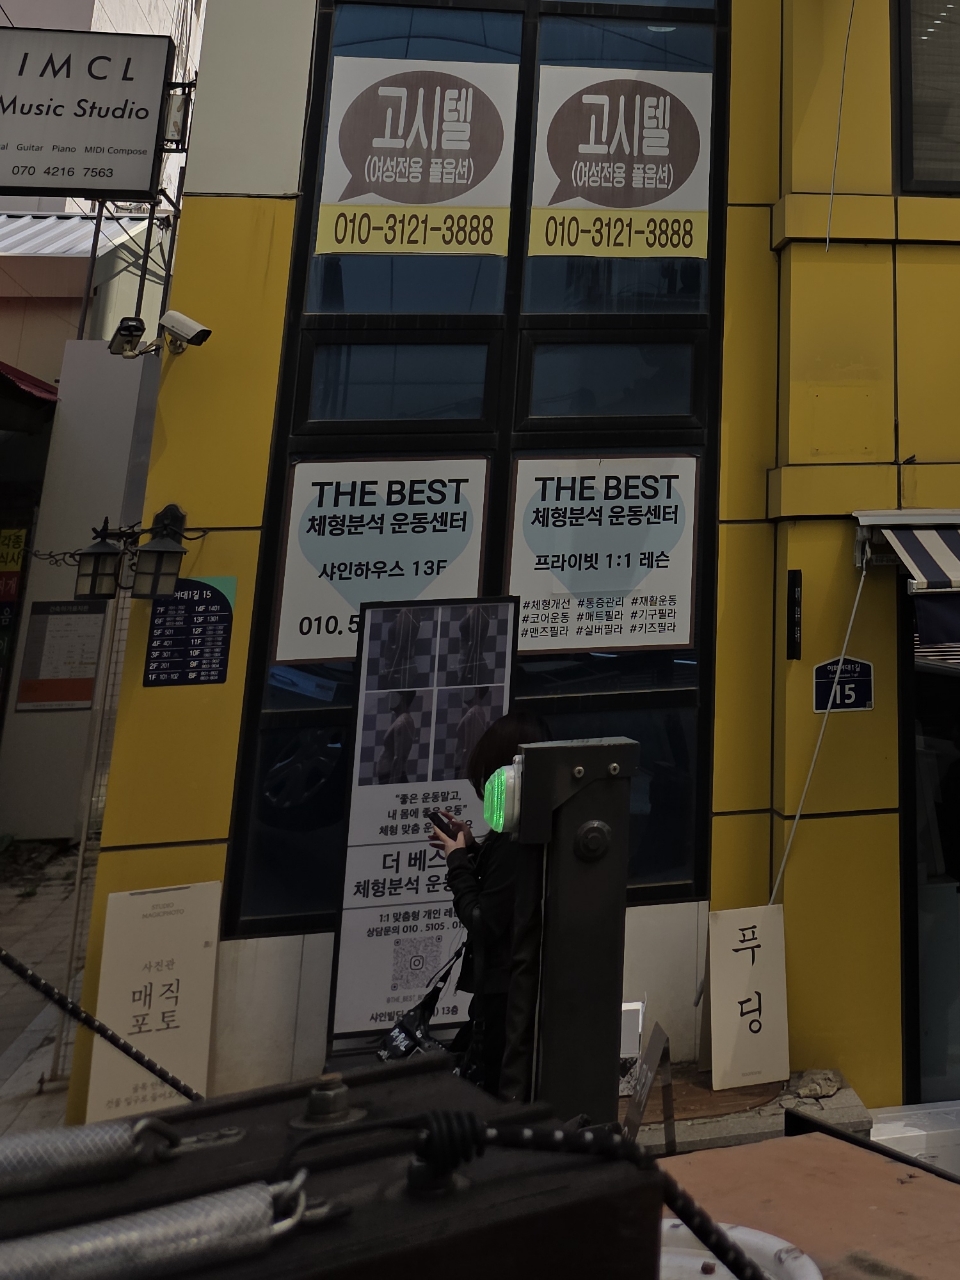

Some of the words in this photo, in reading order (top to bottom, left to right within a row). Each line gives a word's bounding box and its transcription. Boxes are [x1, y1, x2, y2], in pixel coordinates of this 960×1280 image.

[18, 52, 135, 81] IMCL
[0, 95, 65, 117] Music
[73, 98, 149, 120] Studio
[372, 86, 473, 151] 고시텔
[578, 94, 671, 157] 고시텔
[16, 144, 44, 152] Guitar
[52, 145, 77, 153] Piano
[84, 146, 105, 154] MIDI
[107, 147, 148, 156] Compose
[12, 166, 36, 176] 070
[43, 167, 75, 177] 4216
[83, 167, 114, 178] 7563
[364, 156, 423, 184] (여성전용
[571, 160, 626, 189] (여성전용
[334, 212, 494, 246] 010-3121-3888
[545, 215, 694, 249] 010-3121-3888
[311, 480, 378, 508] THE
[386, 478, 469, 506] BEST
[534, 476, 596, 502] THE
[603, 474, 680, 501] BEST
[306, 513, 385, 537] 체형분석
[390, 511, 467, 534] 운동센터
[531, 506, 603, 528] 체형분석
[608, 505, 679, 526] 운동센터
[1, 535, 24, 550] 각종
[318, 560, 405, 581] 샤인하우스
[412, 559, 448, 577] 13F
[534, 553, 599, 572] 프라이빗
[606, 553, 631, 569] 1:1
[639, 551, 671, 569] 레슨
[203, 590, 212, 599] 15
[522, 598, 571, 611] #체형개선
[577, 596, 624, 608] #통증관리
[631, 594, 678, 607] #재활운동
[522, 612, 570, 624] #코어운동
[576, 610, 624, 622] #매트필라
[630, 608, 677, 620] #기구필라
[521, 626, 569, 638] #맨즈필라
[576, 624, 623, 636] #실버필라
[629, 622, 677, 634] #키즈필라
[191, 638, 202, 646] 11F
[150, 651, 160, 659] 3F
[149, 662, 159, 670] 2F
[835, 683, 856, 704] 15
[421, 791, 462, 803] 운동말고,
[387, 809, 398, 820] 내
[400, 807, 419, 820] 몸에
[379, 824, 399, 836] 체형
[401, 823, 420, 835] 맞춤
[382, 851, 401, 874] 더
[408, 849, 446, 872] 베스
[353, 875, 420, 899] 체형분석
[379, 913, 390, 923] 1:1
[393, 910, 420, 923] 맞춤형
[422, 908, 441, 920] 개인
[366, 925, 400, 937] 상담문의
[402, 924, 418, 934] 010
[425, 922, 445, 932] 5105
[142, 957, 176, 972] 사진관
[731, 924, 762, 1034] 푸딩
[131, 978, 181, 1011] 매직
[127, 1009, 181, 1036] 포토
